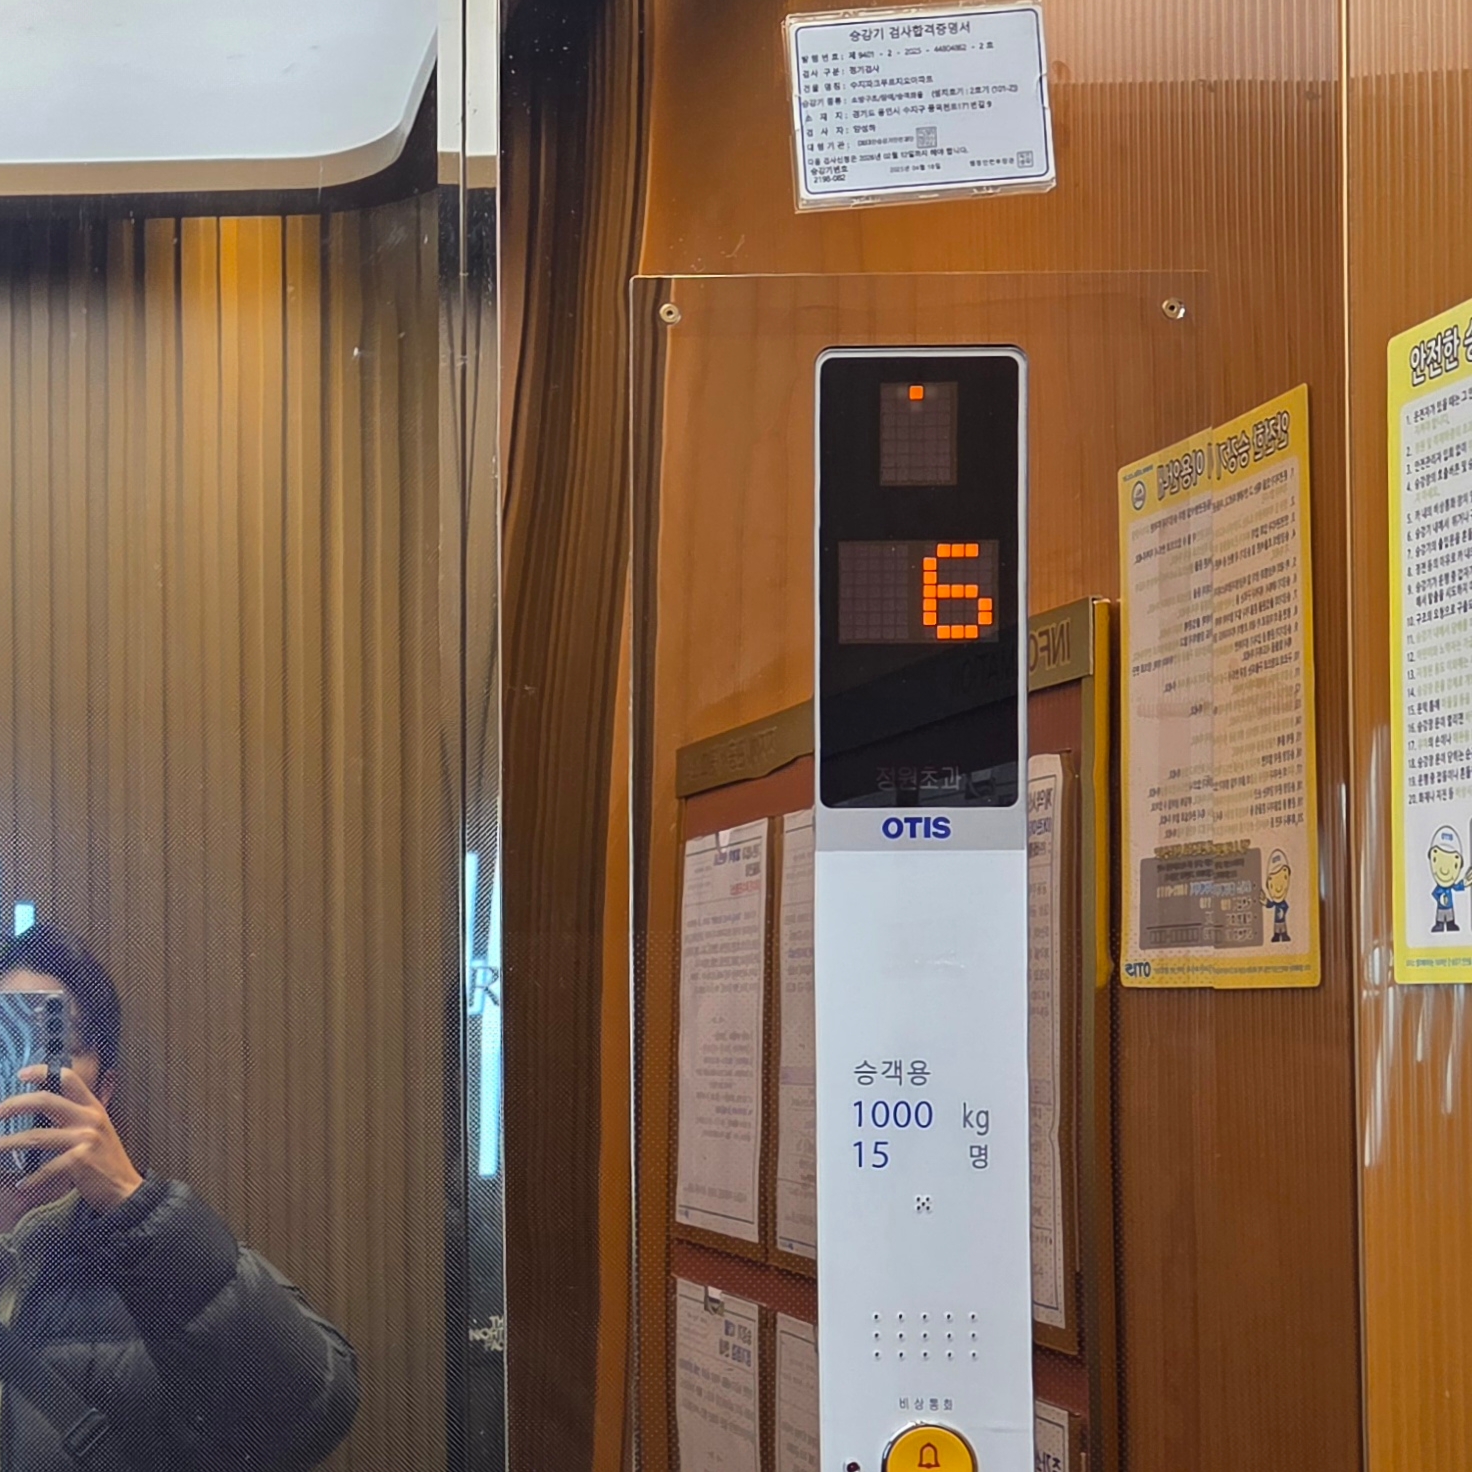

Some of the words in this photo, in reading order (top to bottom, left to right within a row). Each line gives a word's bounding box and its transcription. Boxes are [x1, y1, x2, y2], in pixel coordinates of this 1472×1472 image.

[849, 26, 885, 42] 승강기
[888, 21, 971, 40] 검사합격증명서
[852, 108, 875, 119] 경기도
[878, 106, 900, 117] 용인시
[903, 103, 926, 115] 수지구
[811, 165, 848, 175] 승강기번호
[1410, 326, 1460, 387] 안전한
[922, 543, 993, 639] 6
[882, 816, 951, 840] OTIS
[853, 1059, 931, 1086] 승객용
[853, 1100, 934, 1128] 1000
[962, 1102, 990, 1135] kg
[853, 1140, 890, 1169] 15
[969, 1144, 990, 1170] 명
[899, 1398, 953, 1411] 비상통화
